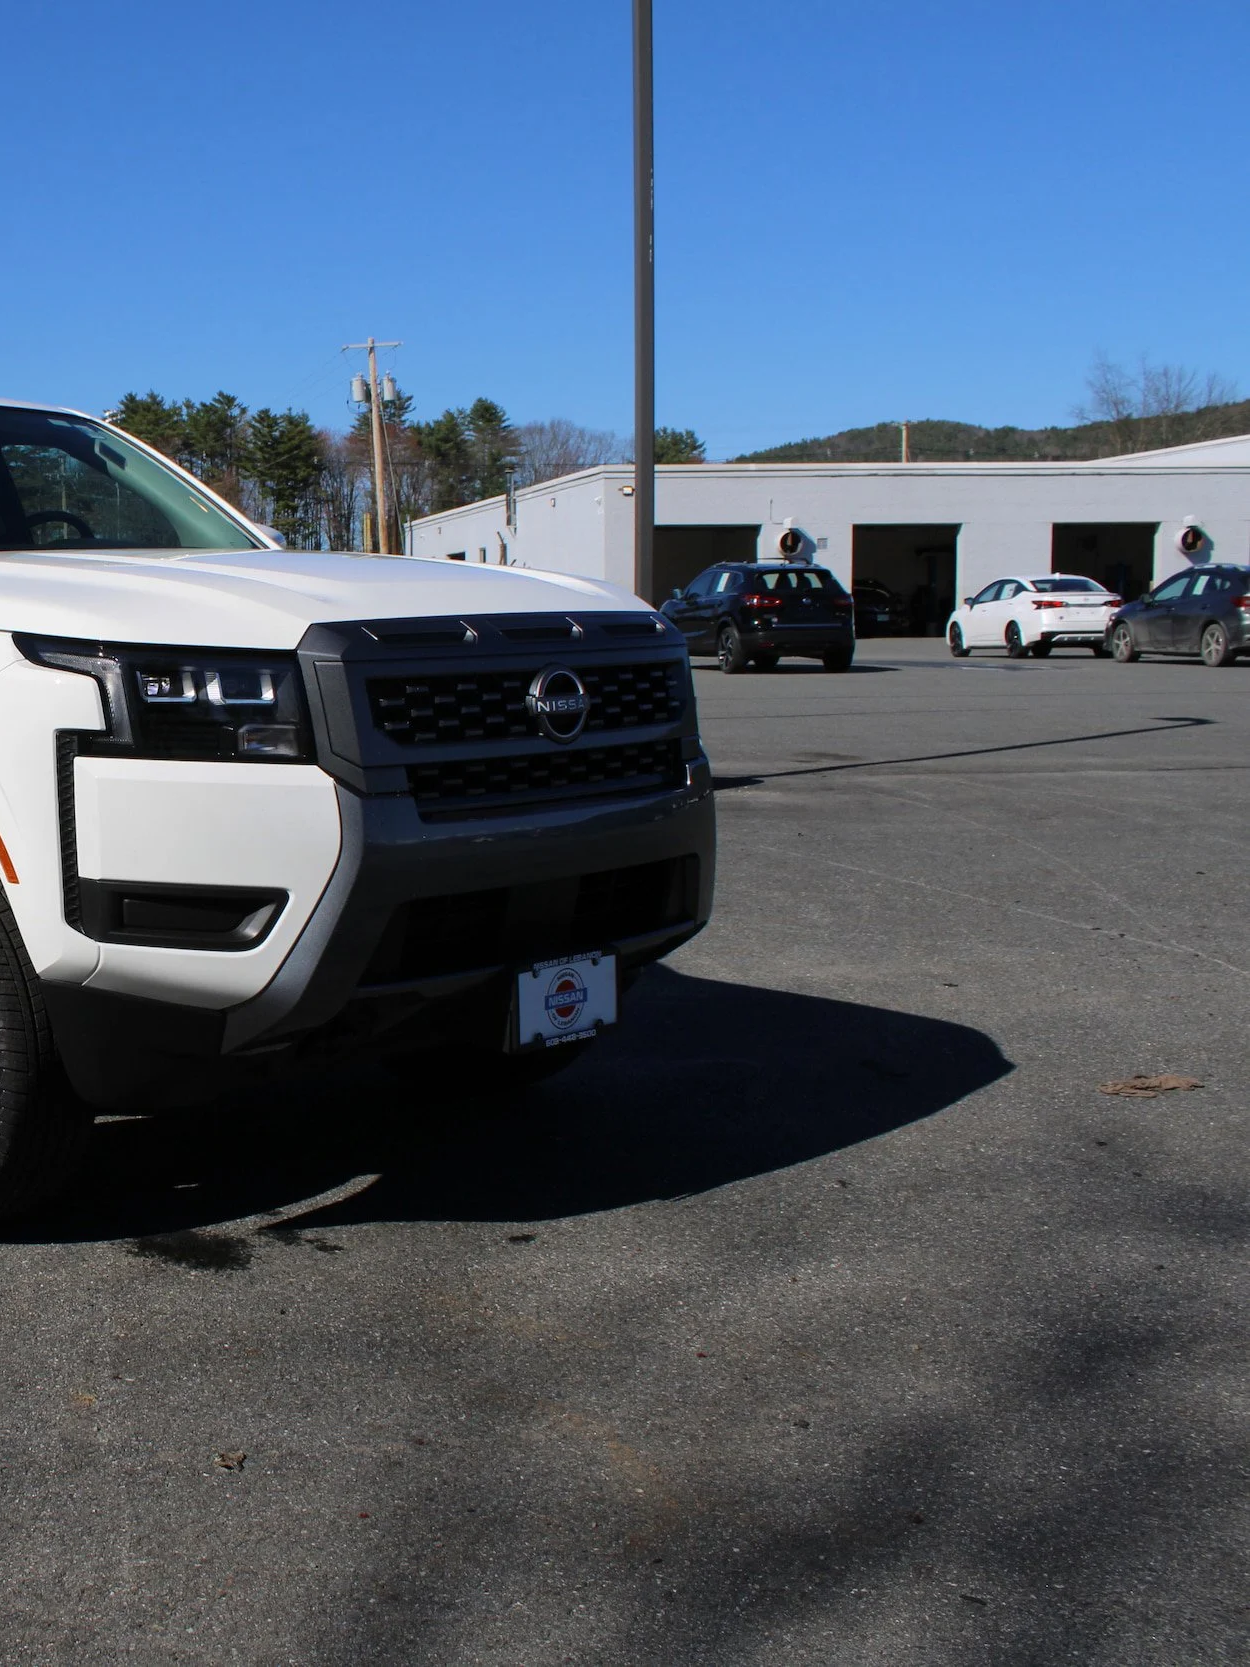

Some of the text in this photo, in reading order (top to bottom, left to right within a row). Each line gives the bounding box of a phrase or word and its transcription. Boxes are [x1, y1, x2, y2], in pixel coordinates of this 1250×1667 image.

[533, 951, 602, 971] NISSAN OF LEBANON
[548, 992, 583, 1006] NISSAN
